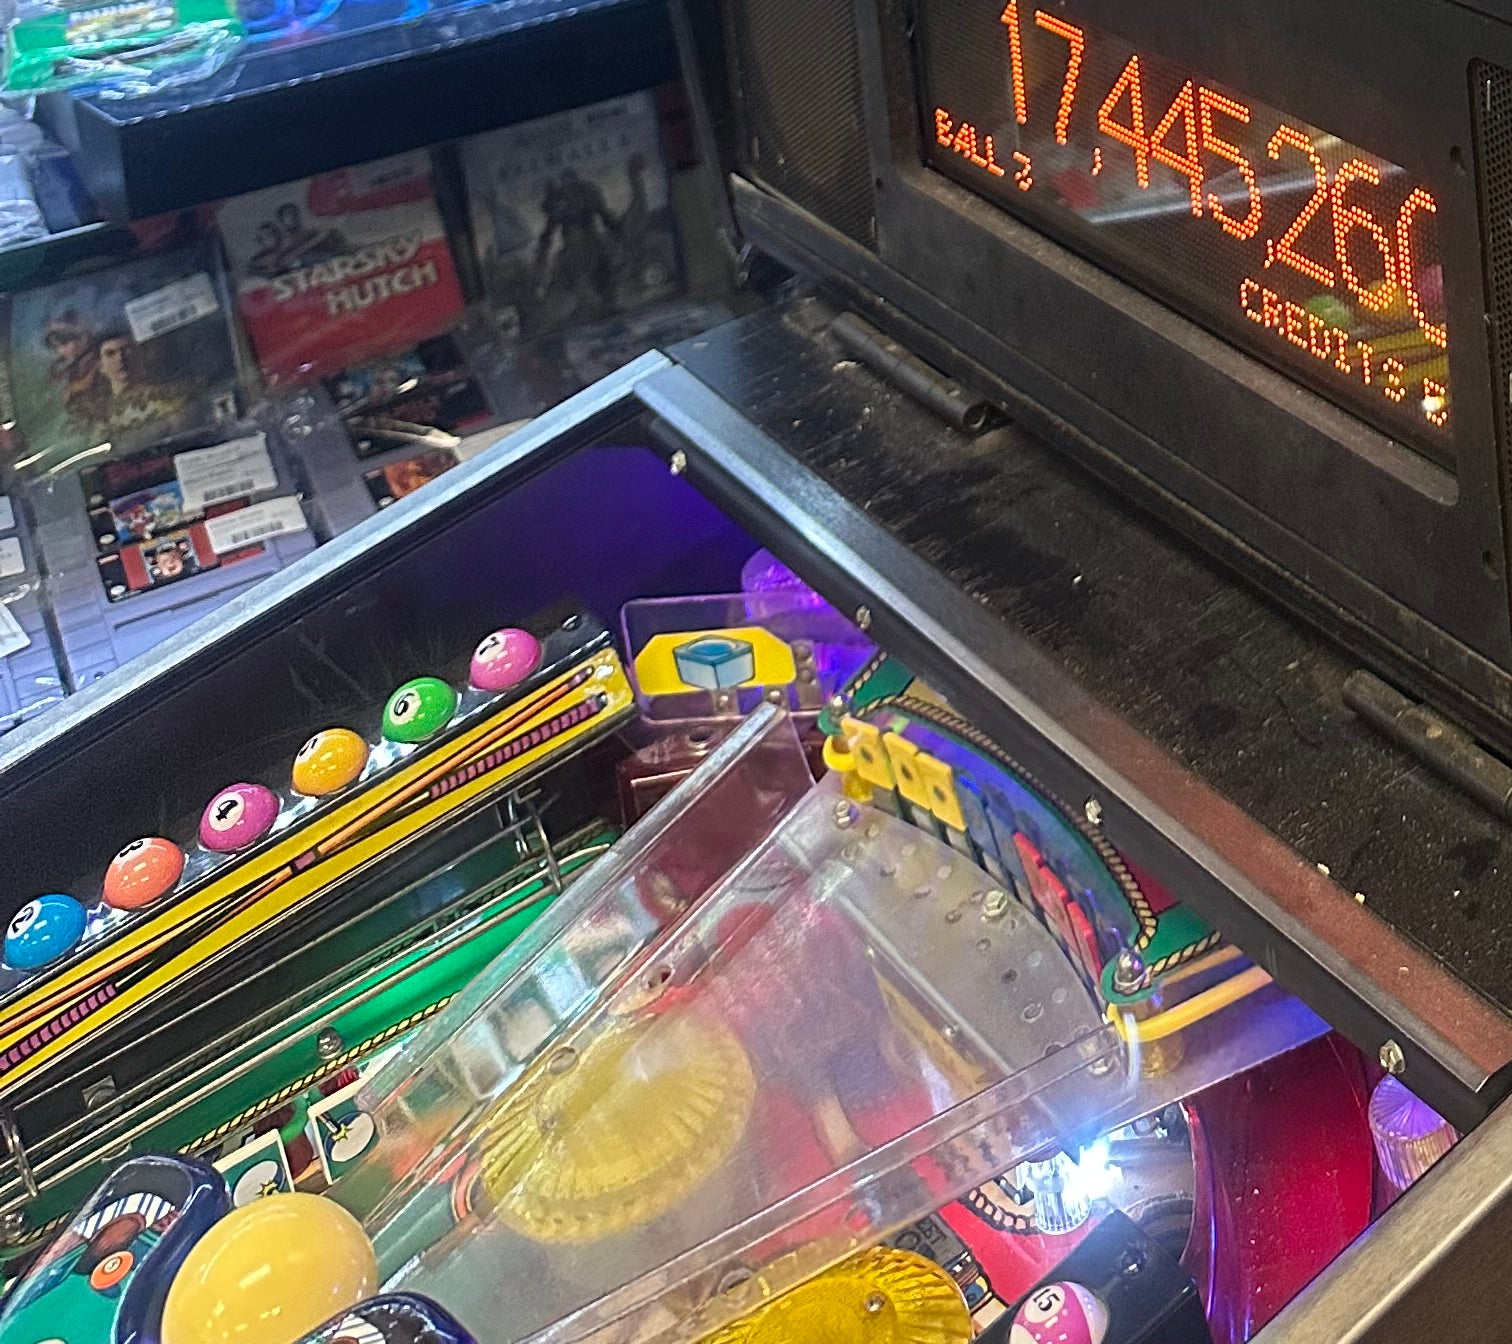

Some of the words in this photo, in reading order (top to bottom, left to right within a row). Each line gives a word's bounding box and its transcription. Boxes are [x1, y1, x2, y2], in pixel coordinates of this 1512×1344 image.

[934, 107, 1006, 177] BALL
[270, 229, 424, 302] STARSKY
[325, 259, 438, 315] HUTCH
[478, 636, 501, 656] 7
[393, 691, 416, 719] 6
[215, 798, 239, 823] 4
[10, 905, 37, 934] 2
[1032, 1286, 1061, 1312] 15
